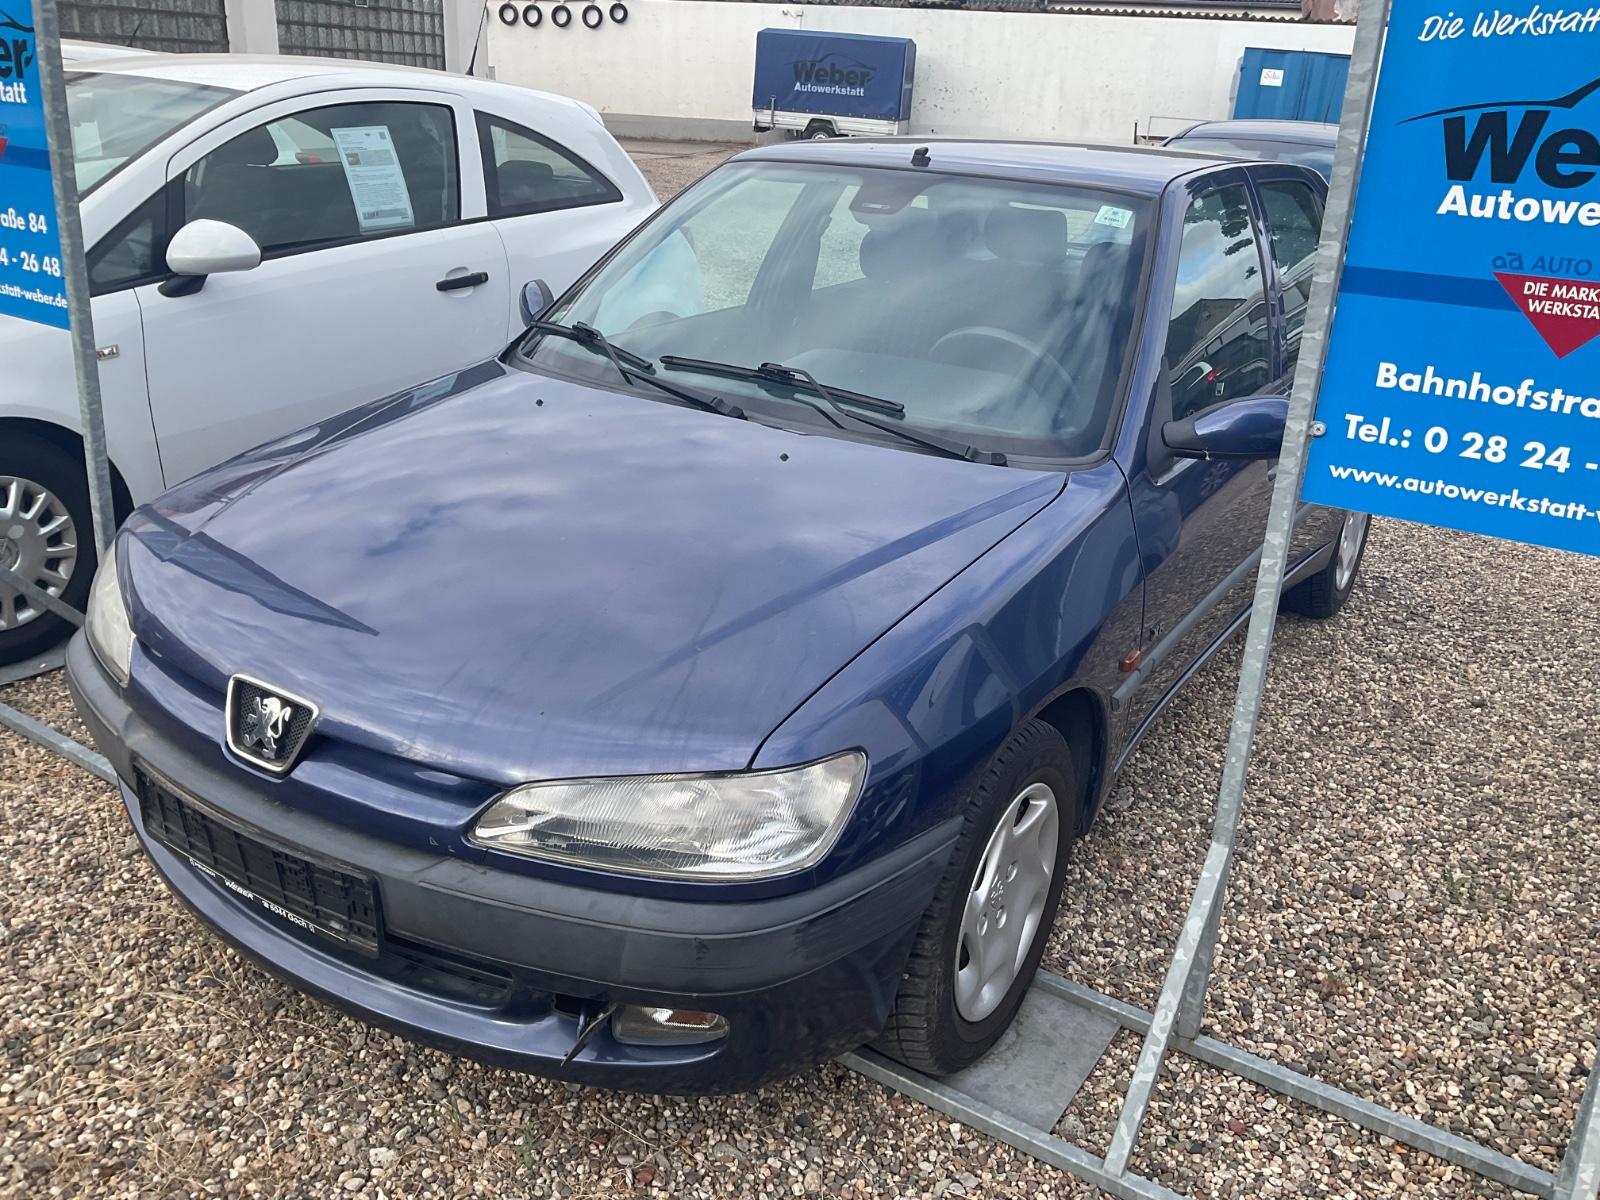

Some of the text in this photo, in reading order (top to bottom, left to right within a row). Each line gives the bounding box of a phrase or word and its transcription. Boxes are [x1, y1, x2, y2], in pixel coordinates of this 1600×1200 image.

[1417, 5, 1600, 42] Die Werkstatt
[792, 62, 874, 88] Weber
[794, 81, 865, 97] Autowerkstatt
[1443, 109, 1600, 189] We
[1436, 185, 1600, 227] Autowe
[28, 212, 48, 234] 84
[0, 247, 9, 266] 4
[20, 251, 40, 273] 26
[42, 255, 61, 277] 48
[1531, 255, 1593, 276] AUTO
[1523, 281, 1600, 303] DIE MARK
[1528, 298, 1600, 320] WERKSTA
[1376, 361, 1600, 419] Bahnhofstra
[1344, 413, 1413, 449] Tel.:
[1424, 426, 1449, 454] 0
[1458, 431, 1508, 463] 28
[1519, 441, 1572, 474] 24
[1329, 463, 1600, 523] www.autowerkstatt-
[224, 878, 255, 901] WEBER
[287, 912, 308, 928] Goch
